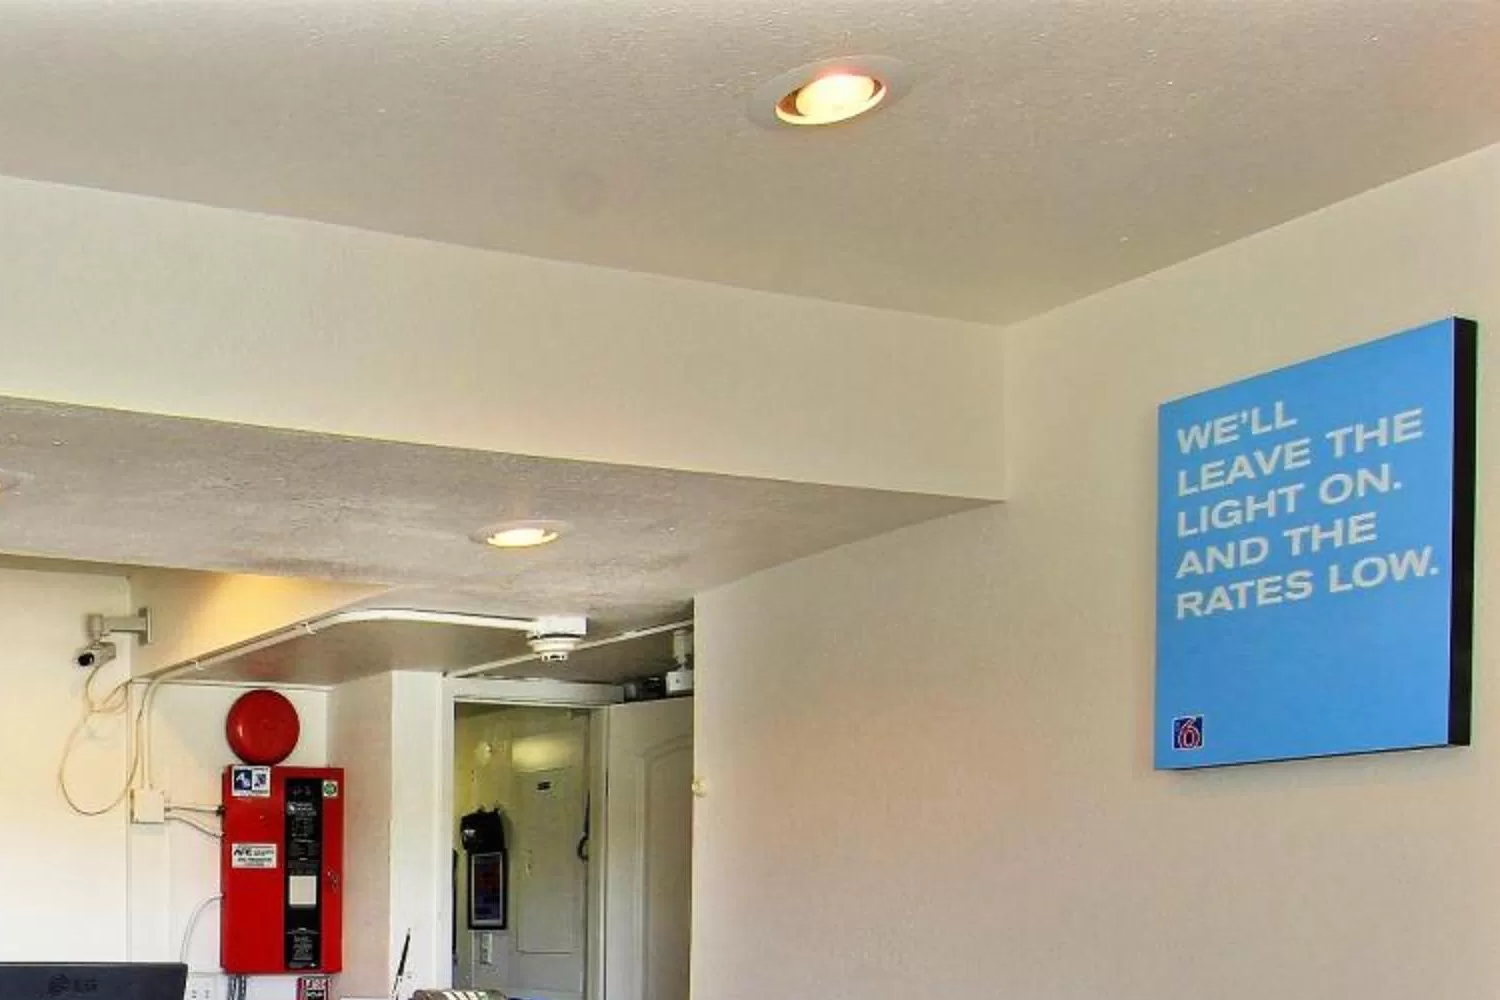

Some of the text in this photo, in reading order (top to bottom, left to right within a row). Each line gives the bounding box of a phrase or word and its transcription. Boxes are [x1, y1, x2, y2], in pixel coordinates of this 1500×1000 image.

[1177, 400, 1298, 454] WE'LL
[1178, 408, 1424, 497] LEAVE THE
[1177, 463, 1402, 538] LIGHT ON.
[1176, 512, 1378, 579] AND THE
[1177, 546, 1440, 620] RATES LOW.
[1178, 719, 1201, 749] 6
